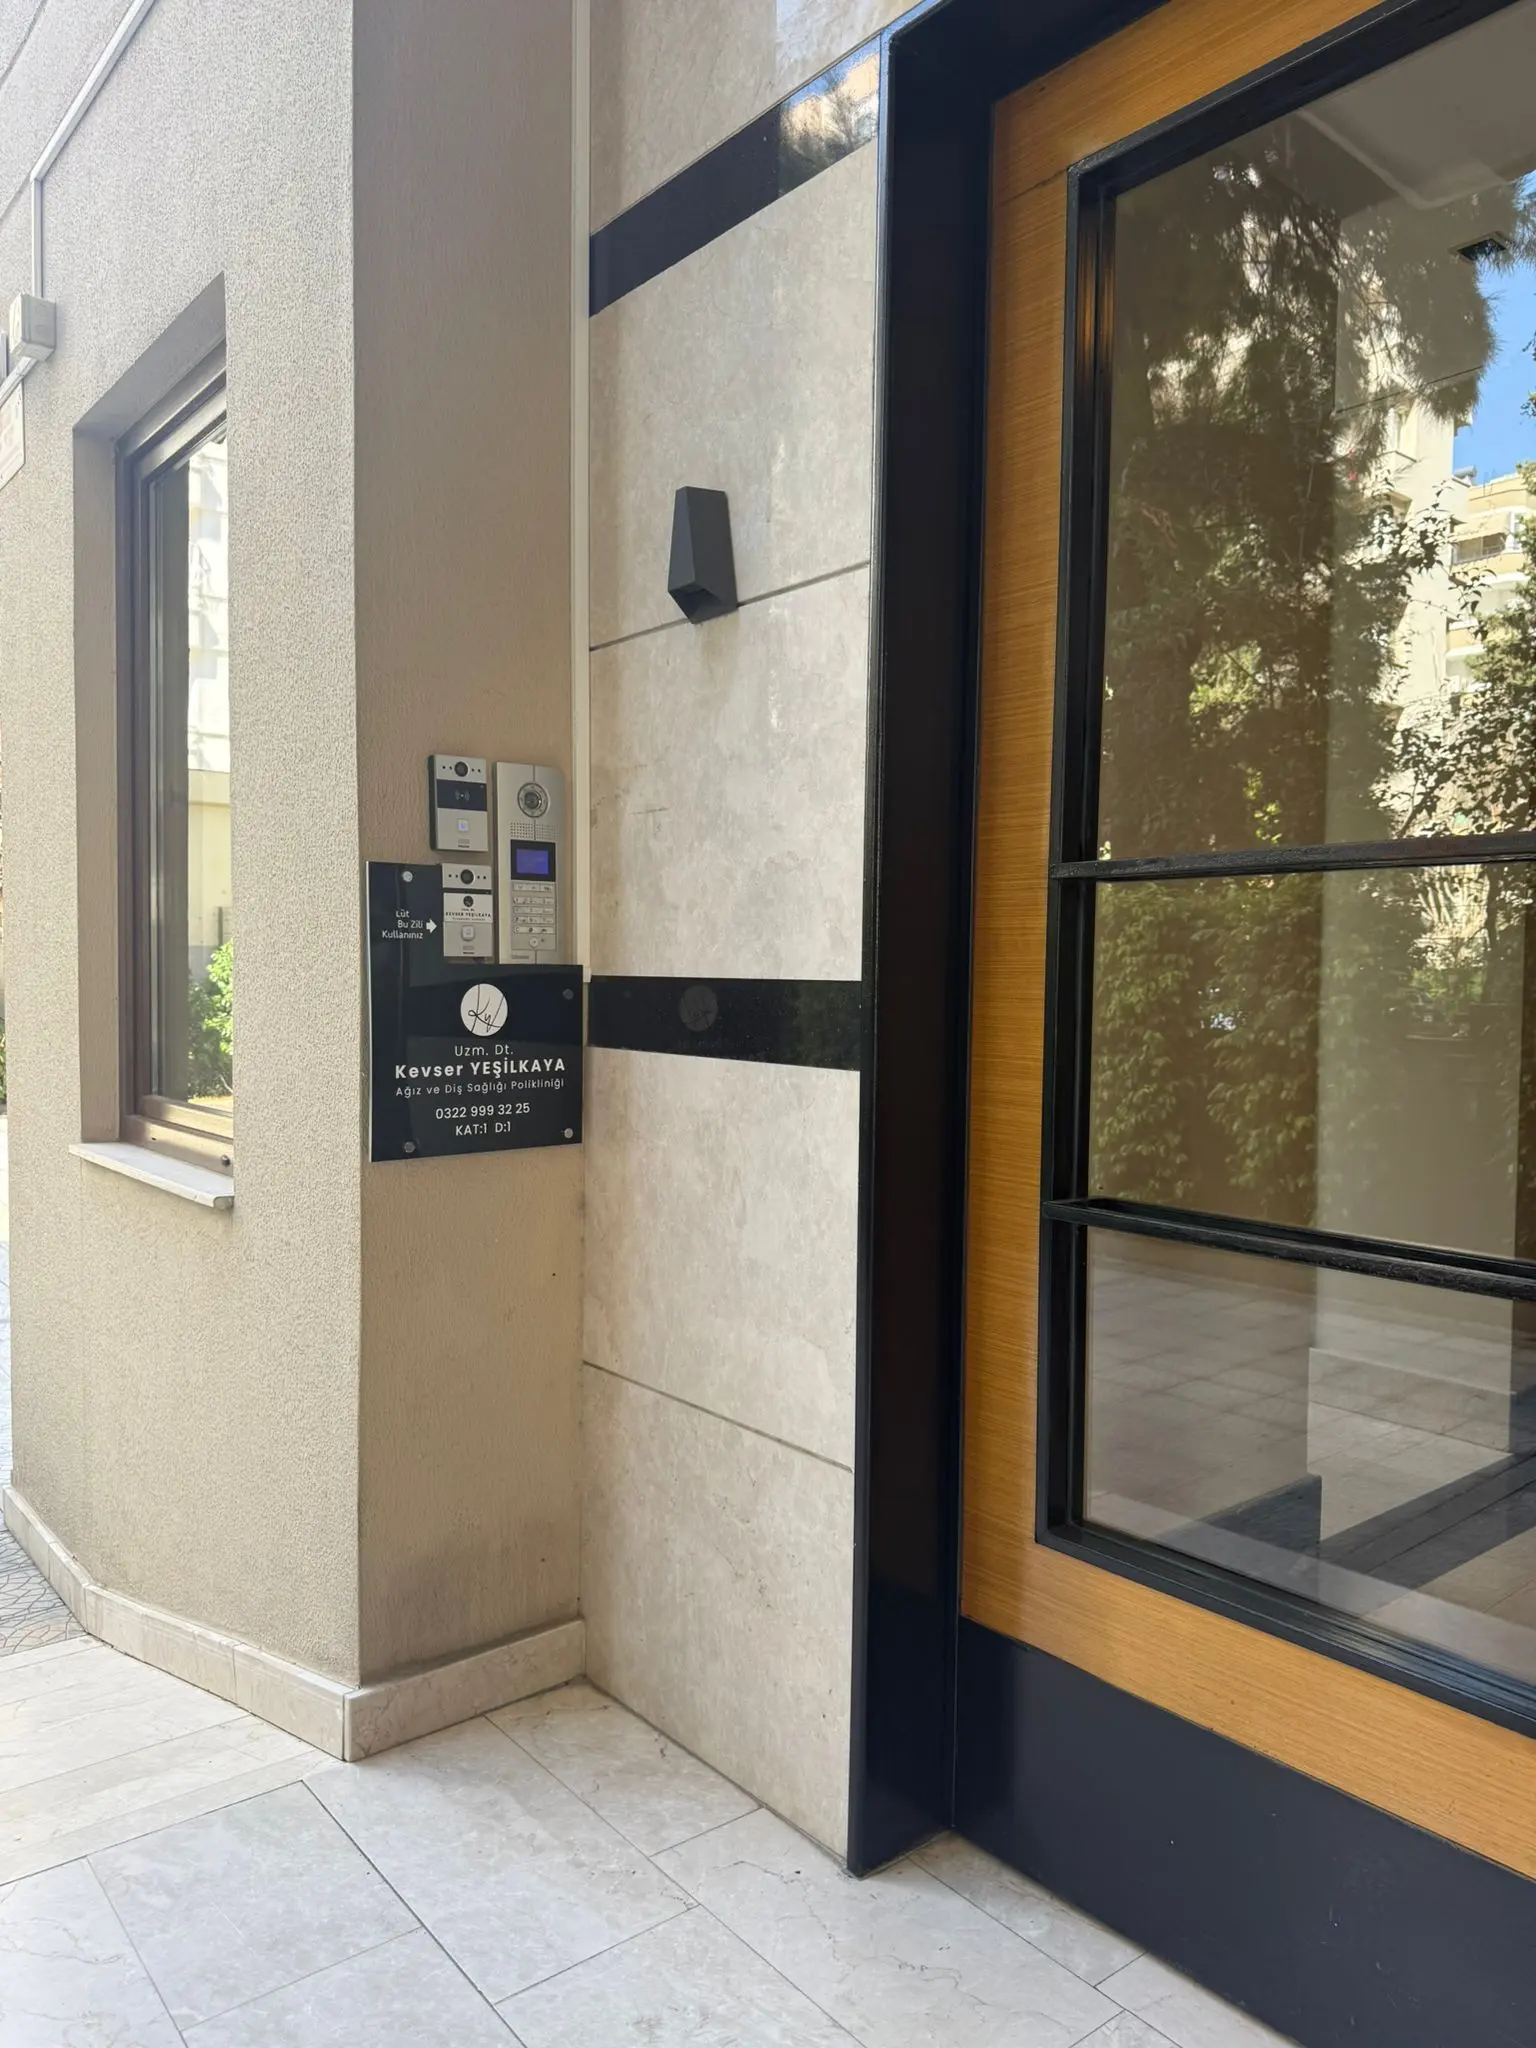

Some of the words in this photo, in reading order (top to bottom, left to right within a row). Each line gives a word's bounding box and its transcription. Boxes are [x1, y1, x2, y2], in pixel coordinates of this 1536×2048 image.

[398, 920, 408, 928] Bu
[411, 920, 423, 928] Zili
[382, 930, 423, 939] Kullanınız
[454, 1045, 489, 1056] Uzm.
[495, 1044, 514, 1055] Dt.
[395, 1063, 464, 1079] Kevser
[470, 1058, 565, 1079] YEŞİLKAYA
[396, 1085, 422, 1098] Ağız
[427, 1085, 440, 1095] ve
[445, 1084, 463, 1095] Diş
[467, 1082, 507, 1094] Sağlığı
[511, 1078, 564, 1090] Polikliniği
[436, 1107, 467, 1119] 0322
[471, 1105, 494, 1117] 999
[498, 1104, 512, 1115] 32
[516, 1102, 530, 1114] 25
[456, 1123, 488, 1136] KAT:1
[495, 1121, 511, 1133] D:1
